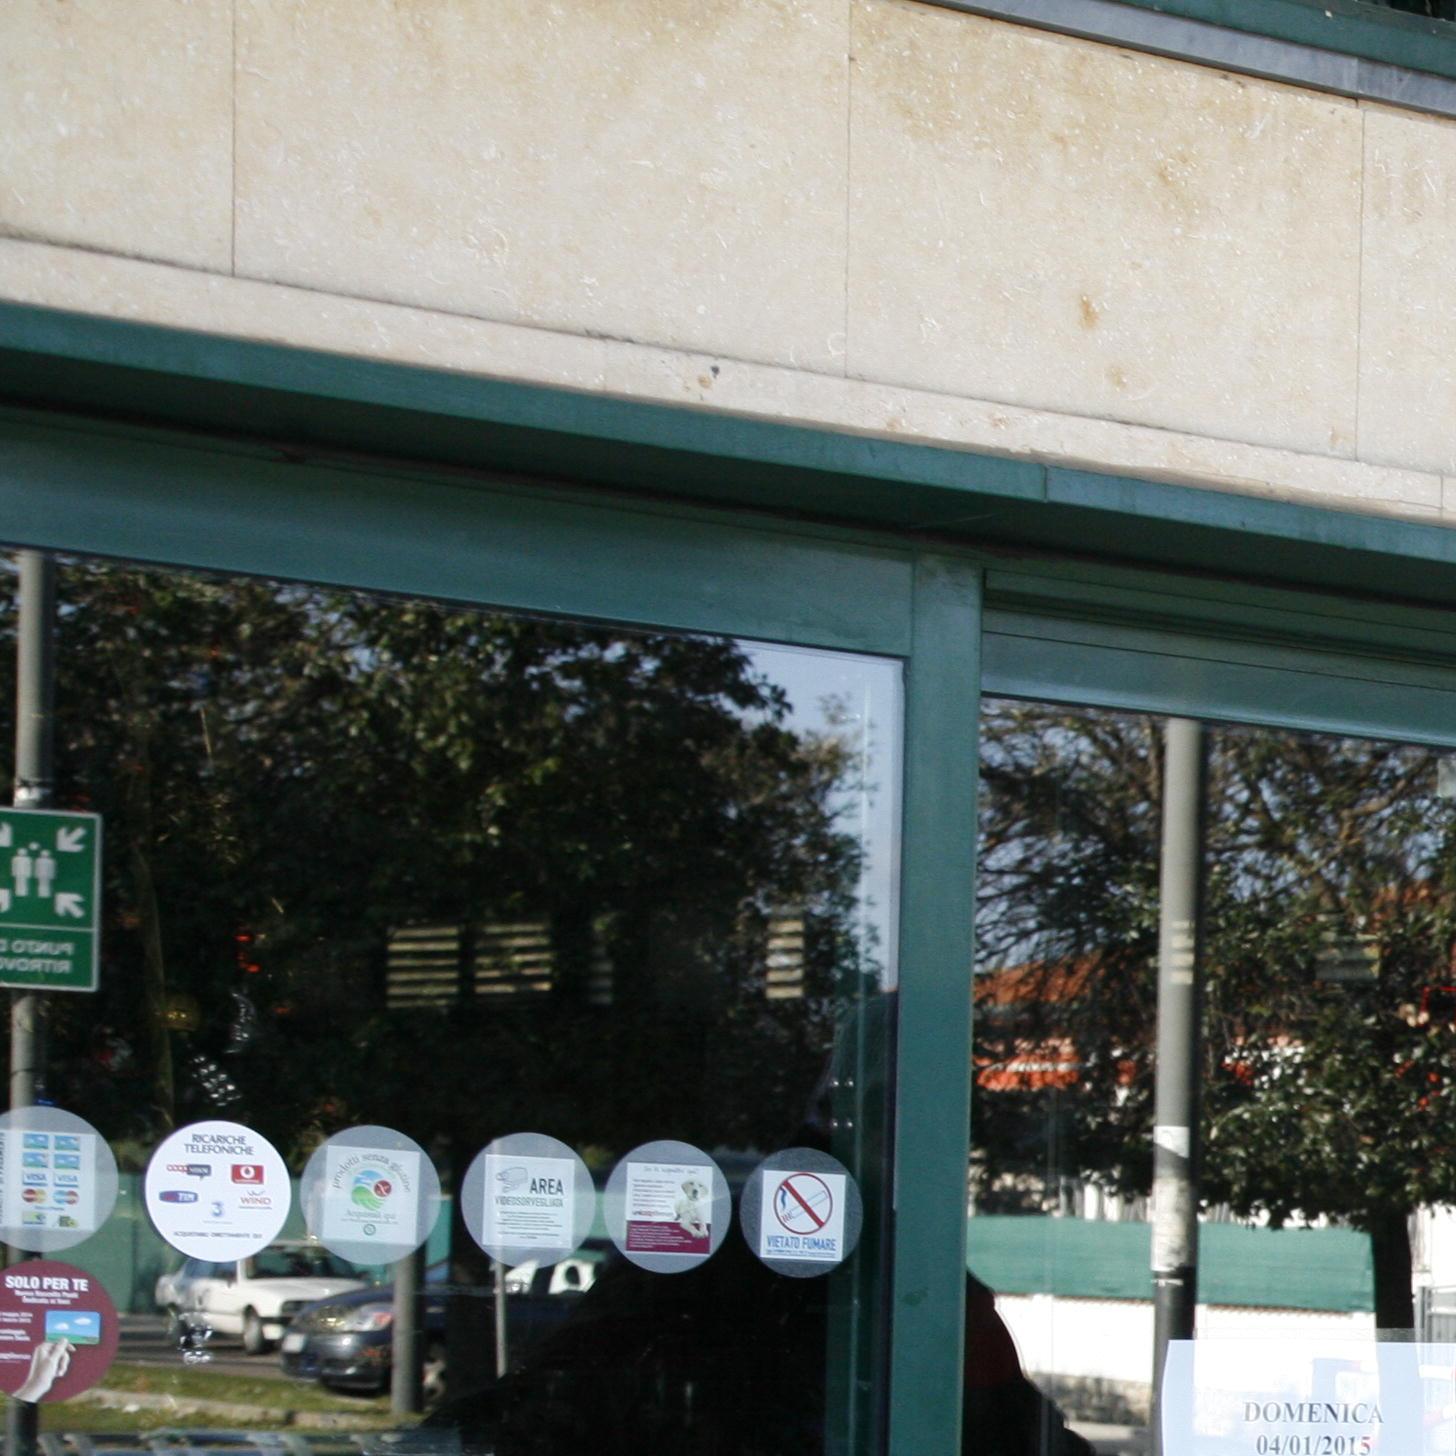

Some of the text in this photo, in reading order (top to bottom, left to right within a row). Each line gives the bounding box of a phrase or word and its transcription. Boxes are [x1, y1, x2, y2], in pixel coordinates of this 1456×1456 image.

[529, 1178, 564, 1195] AREA
[767, 1235, 836, 1251] VIETATO FUMARE
[5, 1275, 88, 1292] SOLO PER TE
[1243, 1402, 1384, 1424] DOMENICA
[1256, 1435, 1372, 1456] 04/01/2015
